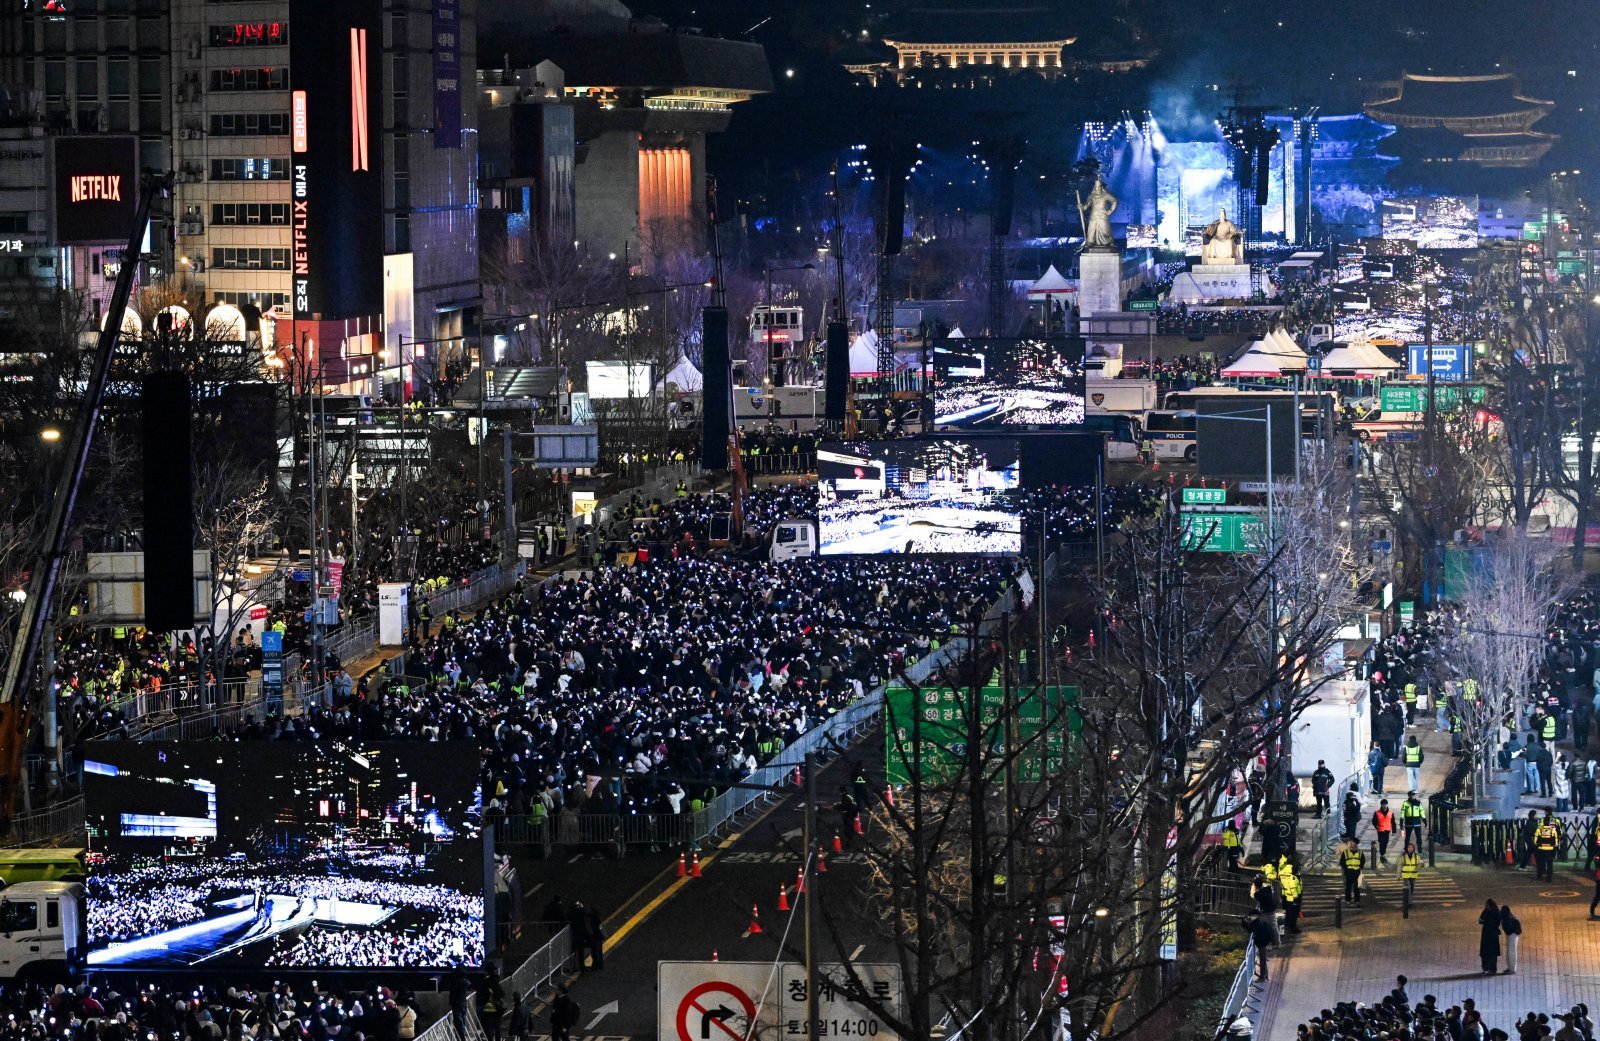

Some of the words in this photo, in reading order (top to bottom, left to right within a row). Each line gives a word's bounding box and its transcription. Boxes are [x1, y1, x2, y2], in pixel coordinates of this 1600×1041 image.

[296, 97, 305, 138] 라이브
[72, 176, 121, 202] NETFLIX
[296, 165, 306, 197] 에서
[295, 200, 309, 275] NETFLIX
[297, 279, 308, 312] 오직
[1202, 280, 1238, 288] 세종대왕
[1187, 491, 1222, 501] 청계광장
